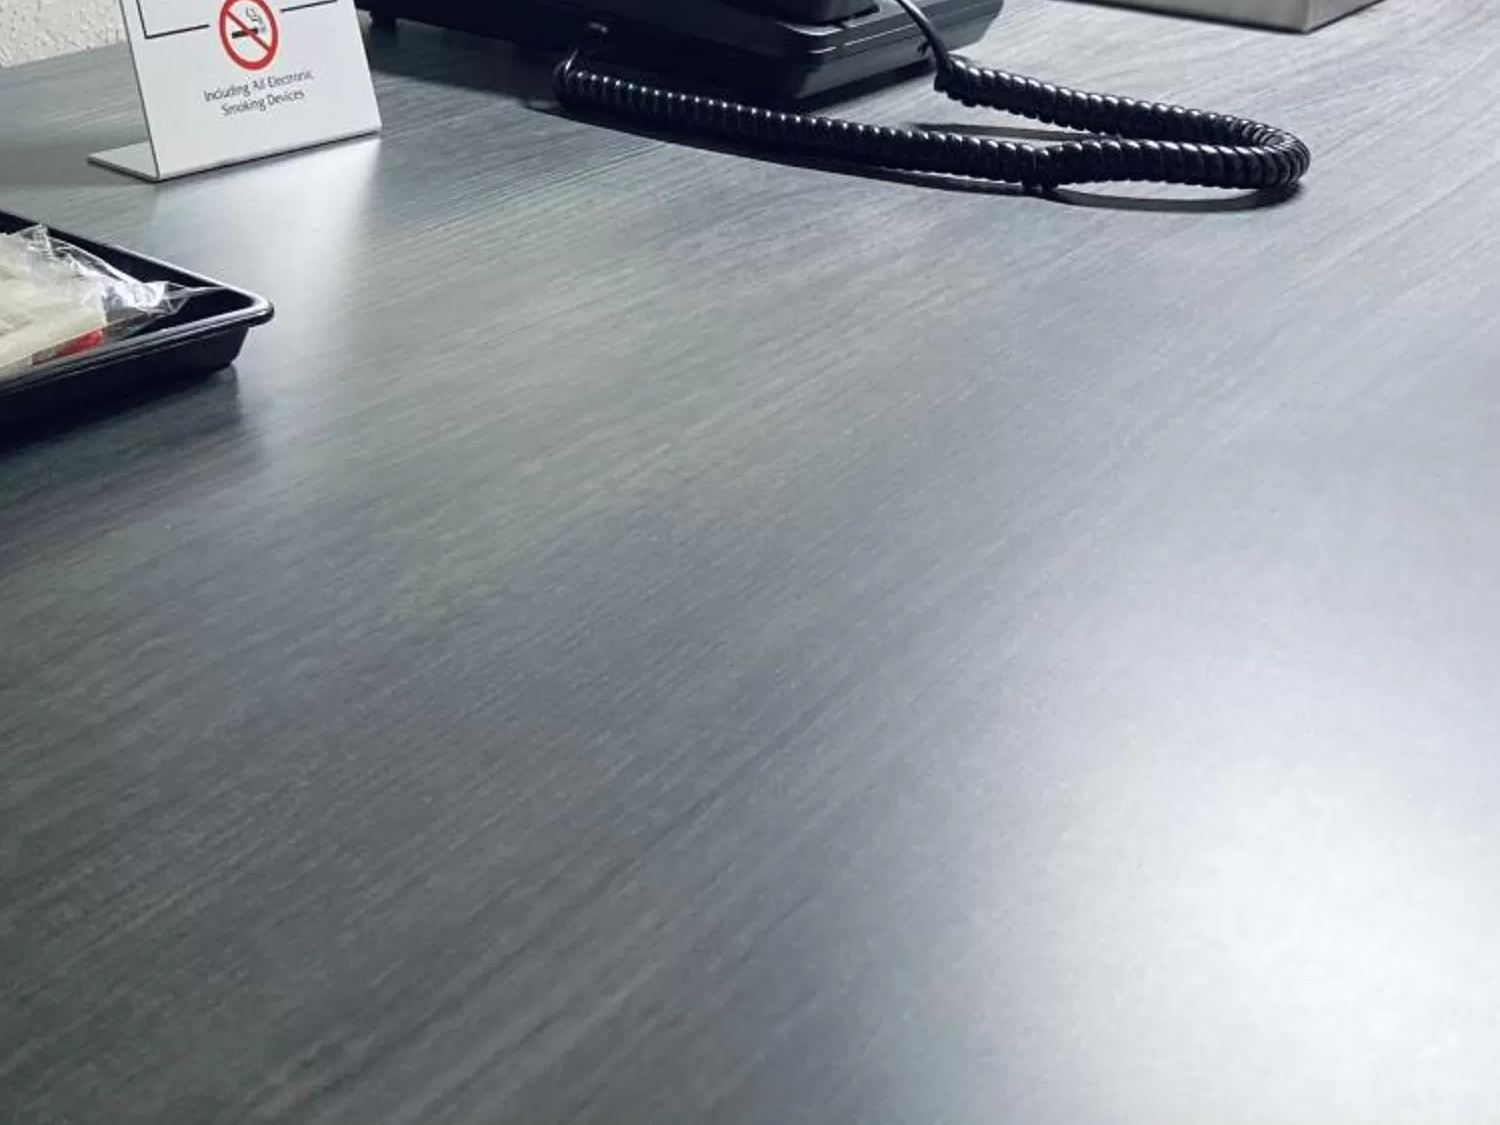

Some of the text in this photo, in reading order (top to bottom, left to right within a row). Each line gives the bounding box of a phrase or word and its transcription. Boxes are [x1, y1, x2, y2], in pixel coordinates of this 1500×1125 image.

[204, 83, 251, 102] Including
[267, 70, 314, 88] Electronic
[221, 89, 305, 115] Smoking Devices
